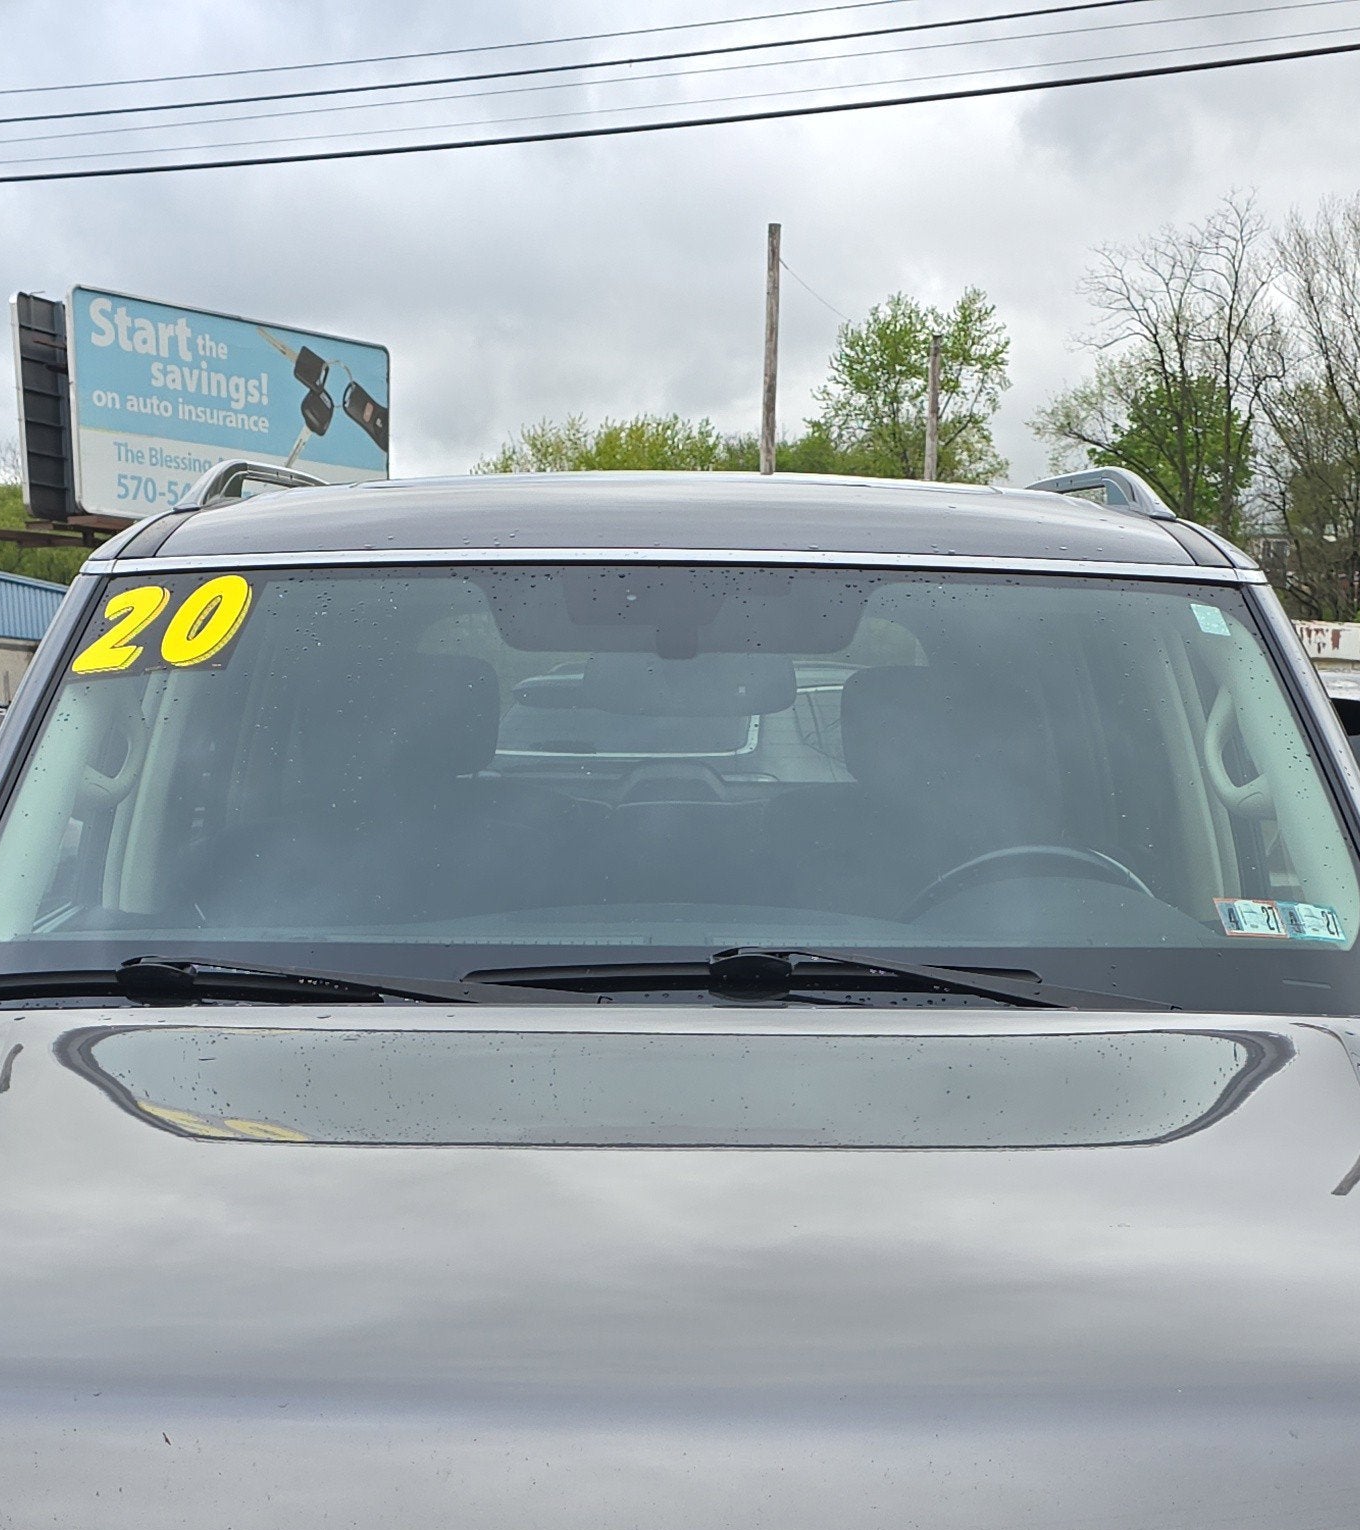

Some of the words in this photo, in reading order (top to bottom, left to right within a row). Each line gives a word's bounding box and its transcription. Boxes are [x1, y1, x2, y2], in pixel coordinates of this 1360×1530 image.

[89, 297, 193, 361] Start
[197, 334, 228, 359] the
[150, 360, 269, 410] savings!
[92, 389, 120, 410] on
[126, 395, 172, 417] auto
[178, 398, 269, 433] insurance
[113, 441, 145, 465] The
[71, 575, 252, 676] 20
